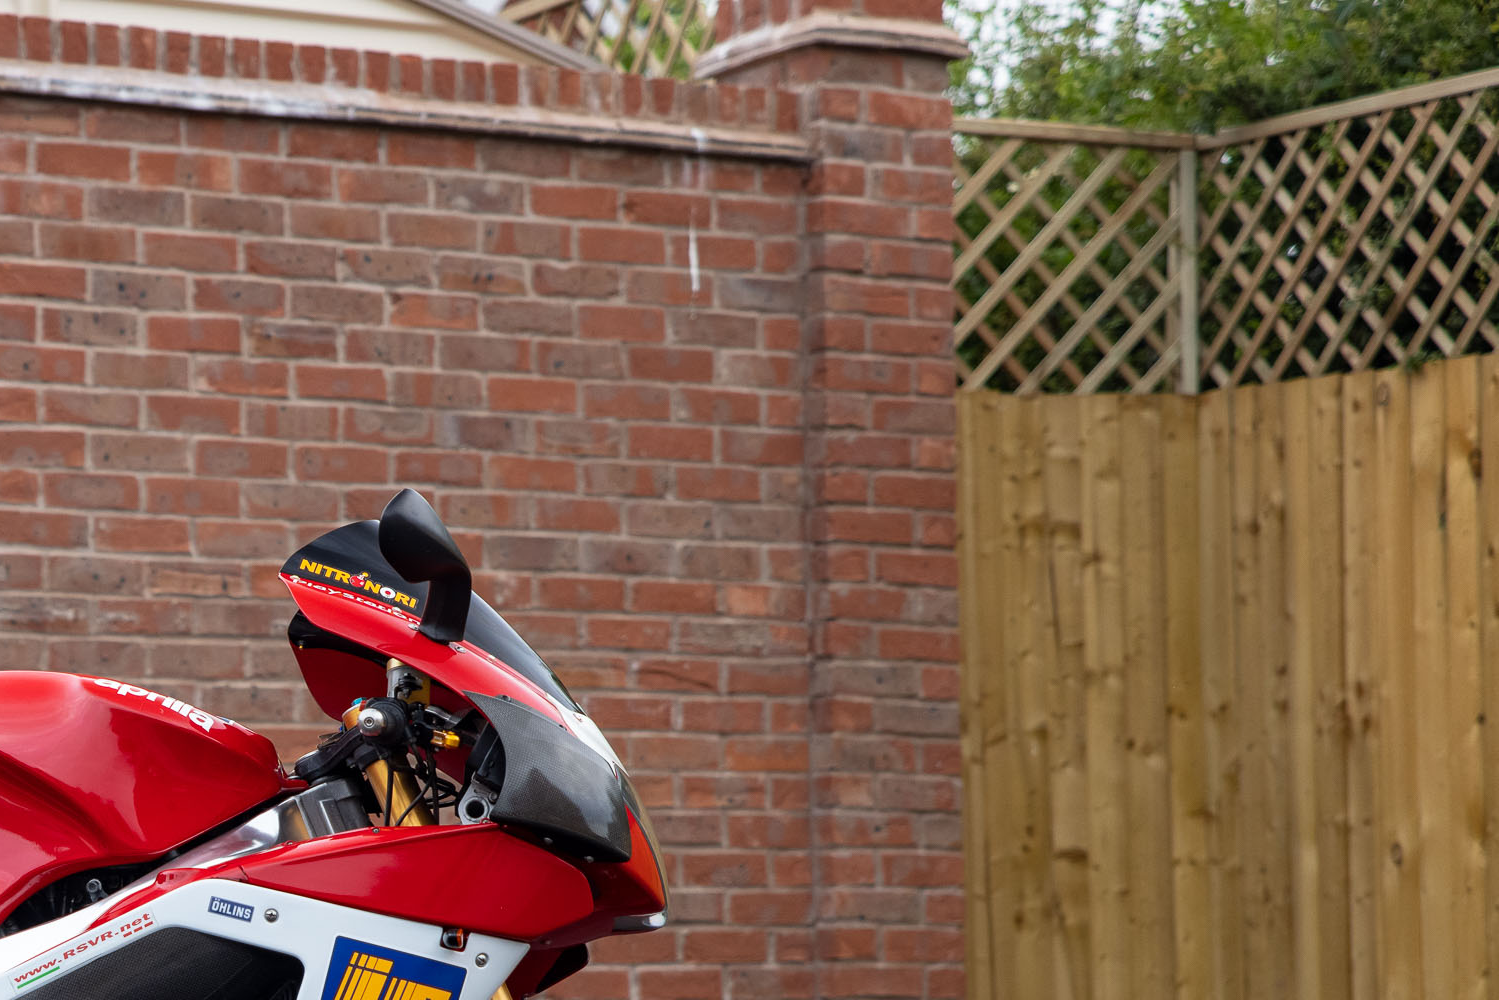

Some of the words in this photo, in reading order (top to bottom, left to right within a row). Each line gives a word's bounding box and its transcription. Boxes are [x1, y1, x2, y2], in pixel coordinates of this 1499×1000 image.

[94, 678, 214, 733] aprilia
[211, 897, 252, 920] ÖHLINS
[14, 912, 152, 983] www.RSVR.net
